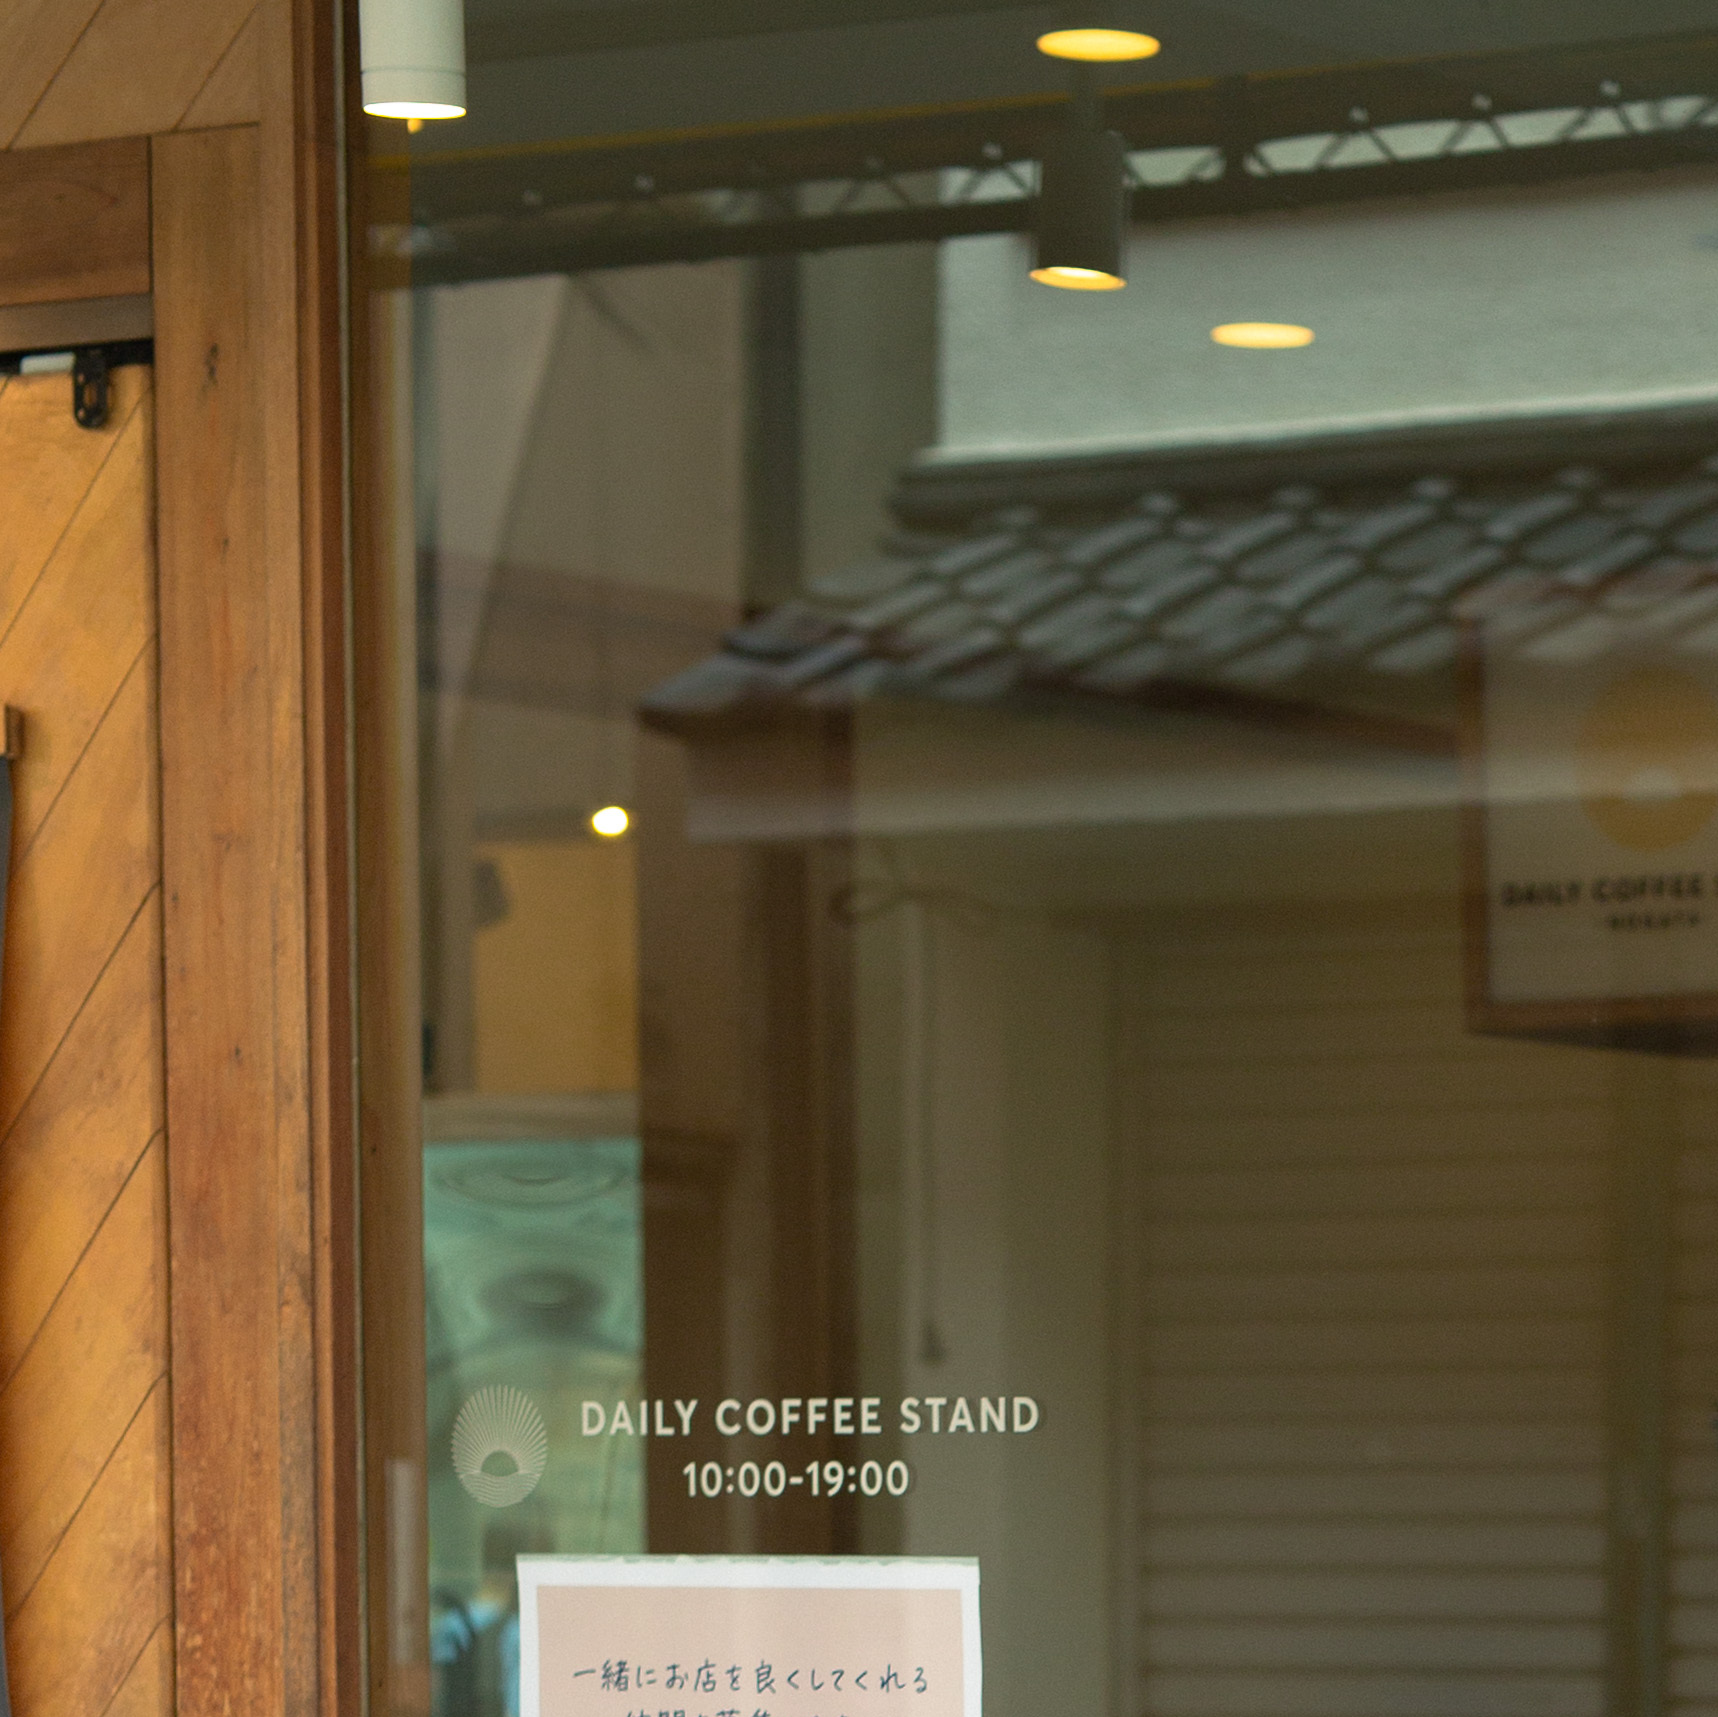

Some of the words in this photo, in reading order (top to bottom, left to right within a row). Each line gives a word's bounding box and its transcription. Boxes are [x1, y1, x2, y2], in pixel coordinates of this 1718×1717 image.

[1501, 879, 1583, 906] DAILY
[1592, 874, 1703, 902] COFFEE
[581, 1398, 698, 1437] DAILY
[714, 1397, 883, 1436] COFFEE
[899, 1396, 1040, 1435] STAND
[682, 1459, 910, 1498] 10:00-19:00
[572, 1657, 929, 1695] 一緒にお店を良くしてくれる
